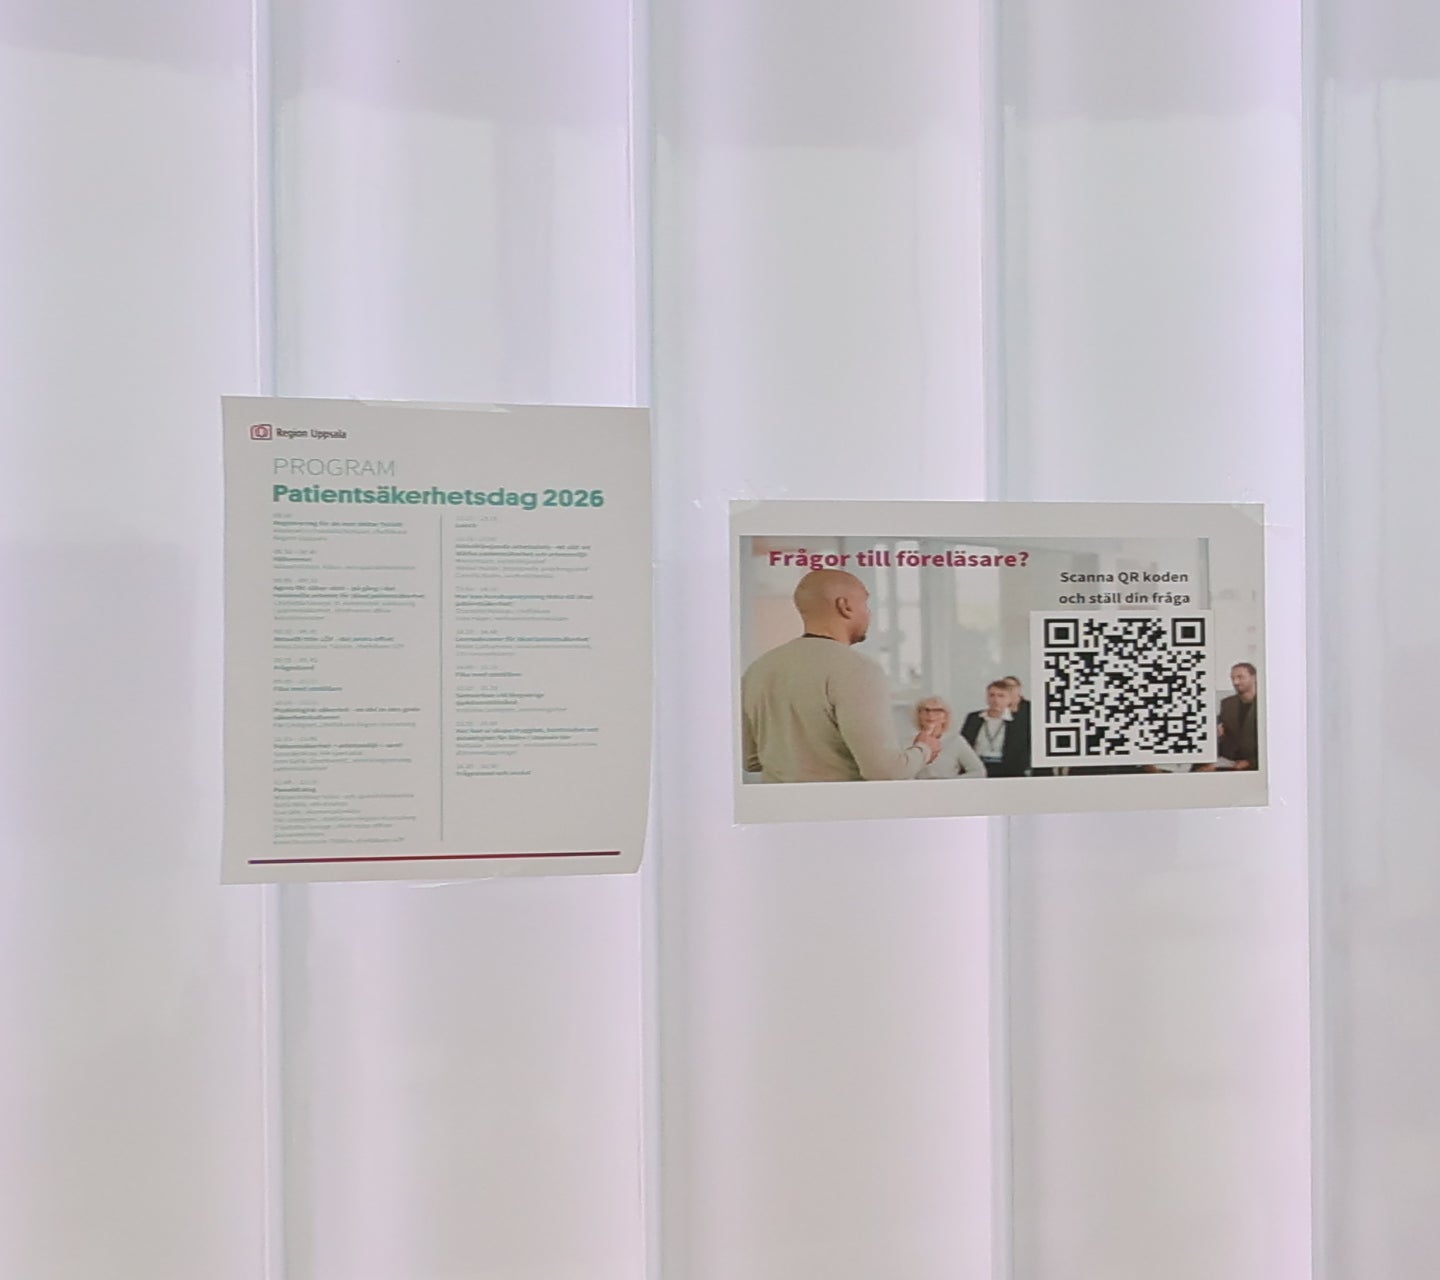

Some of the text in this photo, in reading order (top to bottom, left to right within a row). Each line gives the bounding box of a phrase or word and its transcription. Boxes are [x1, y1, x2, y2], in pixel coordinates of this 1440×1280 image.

[276, 427, 308, 440] Region
[273, 458, 396, 477] PROGRAM
[273, 484, 605, 511] Patientsäkerhetsdag 2026
[768, 548, 1030, 572] Frågor till föreläsare?
[1060, 571, 1189, 586] Scanna QR koden
[1058, 591, 1191, 607] och ställ din fråga
